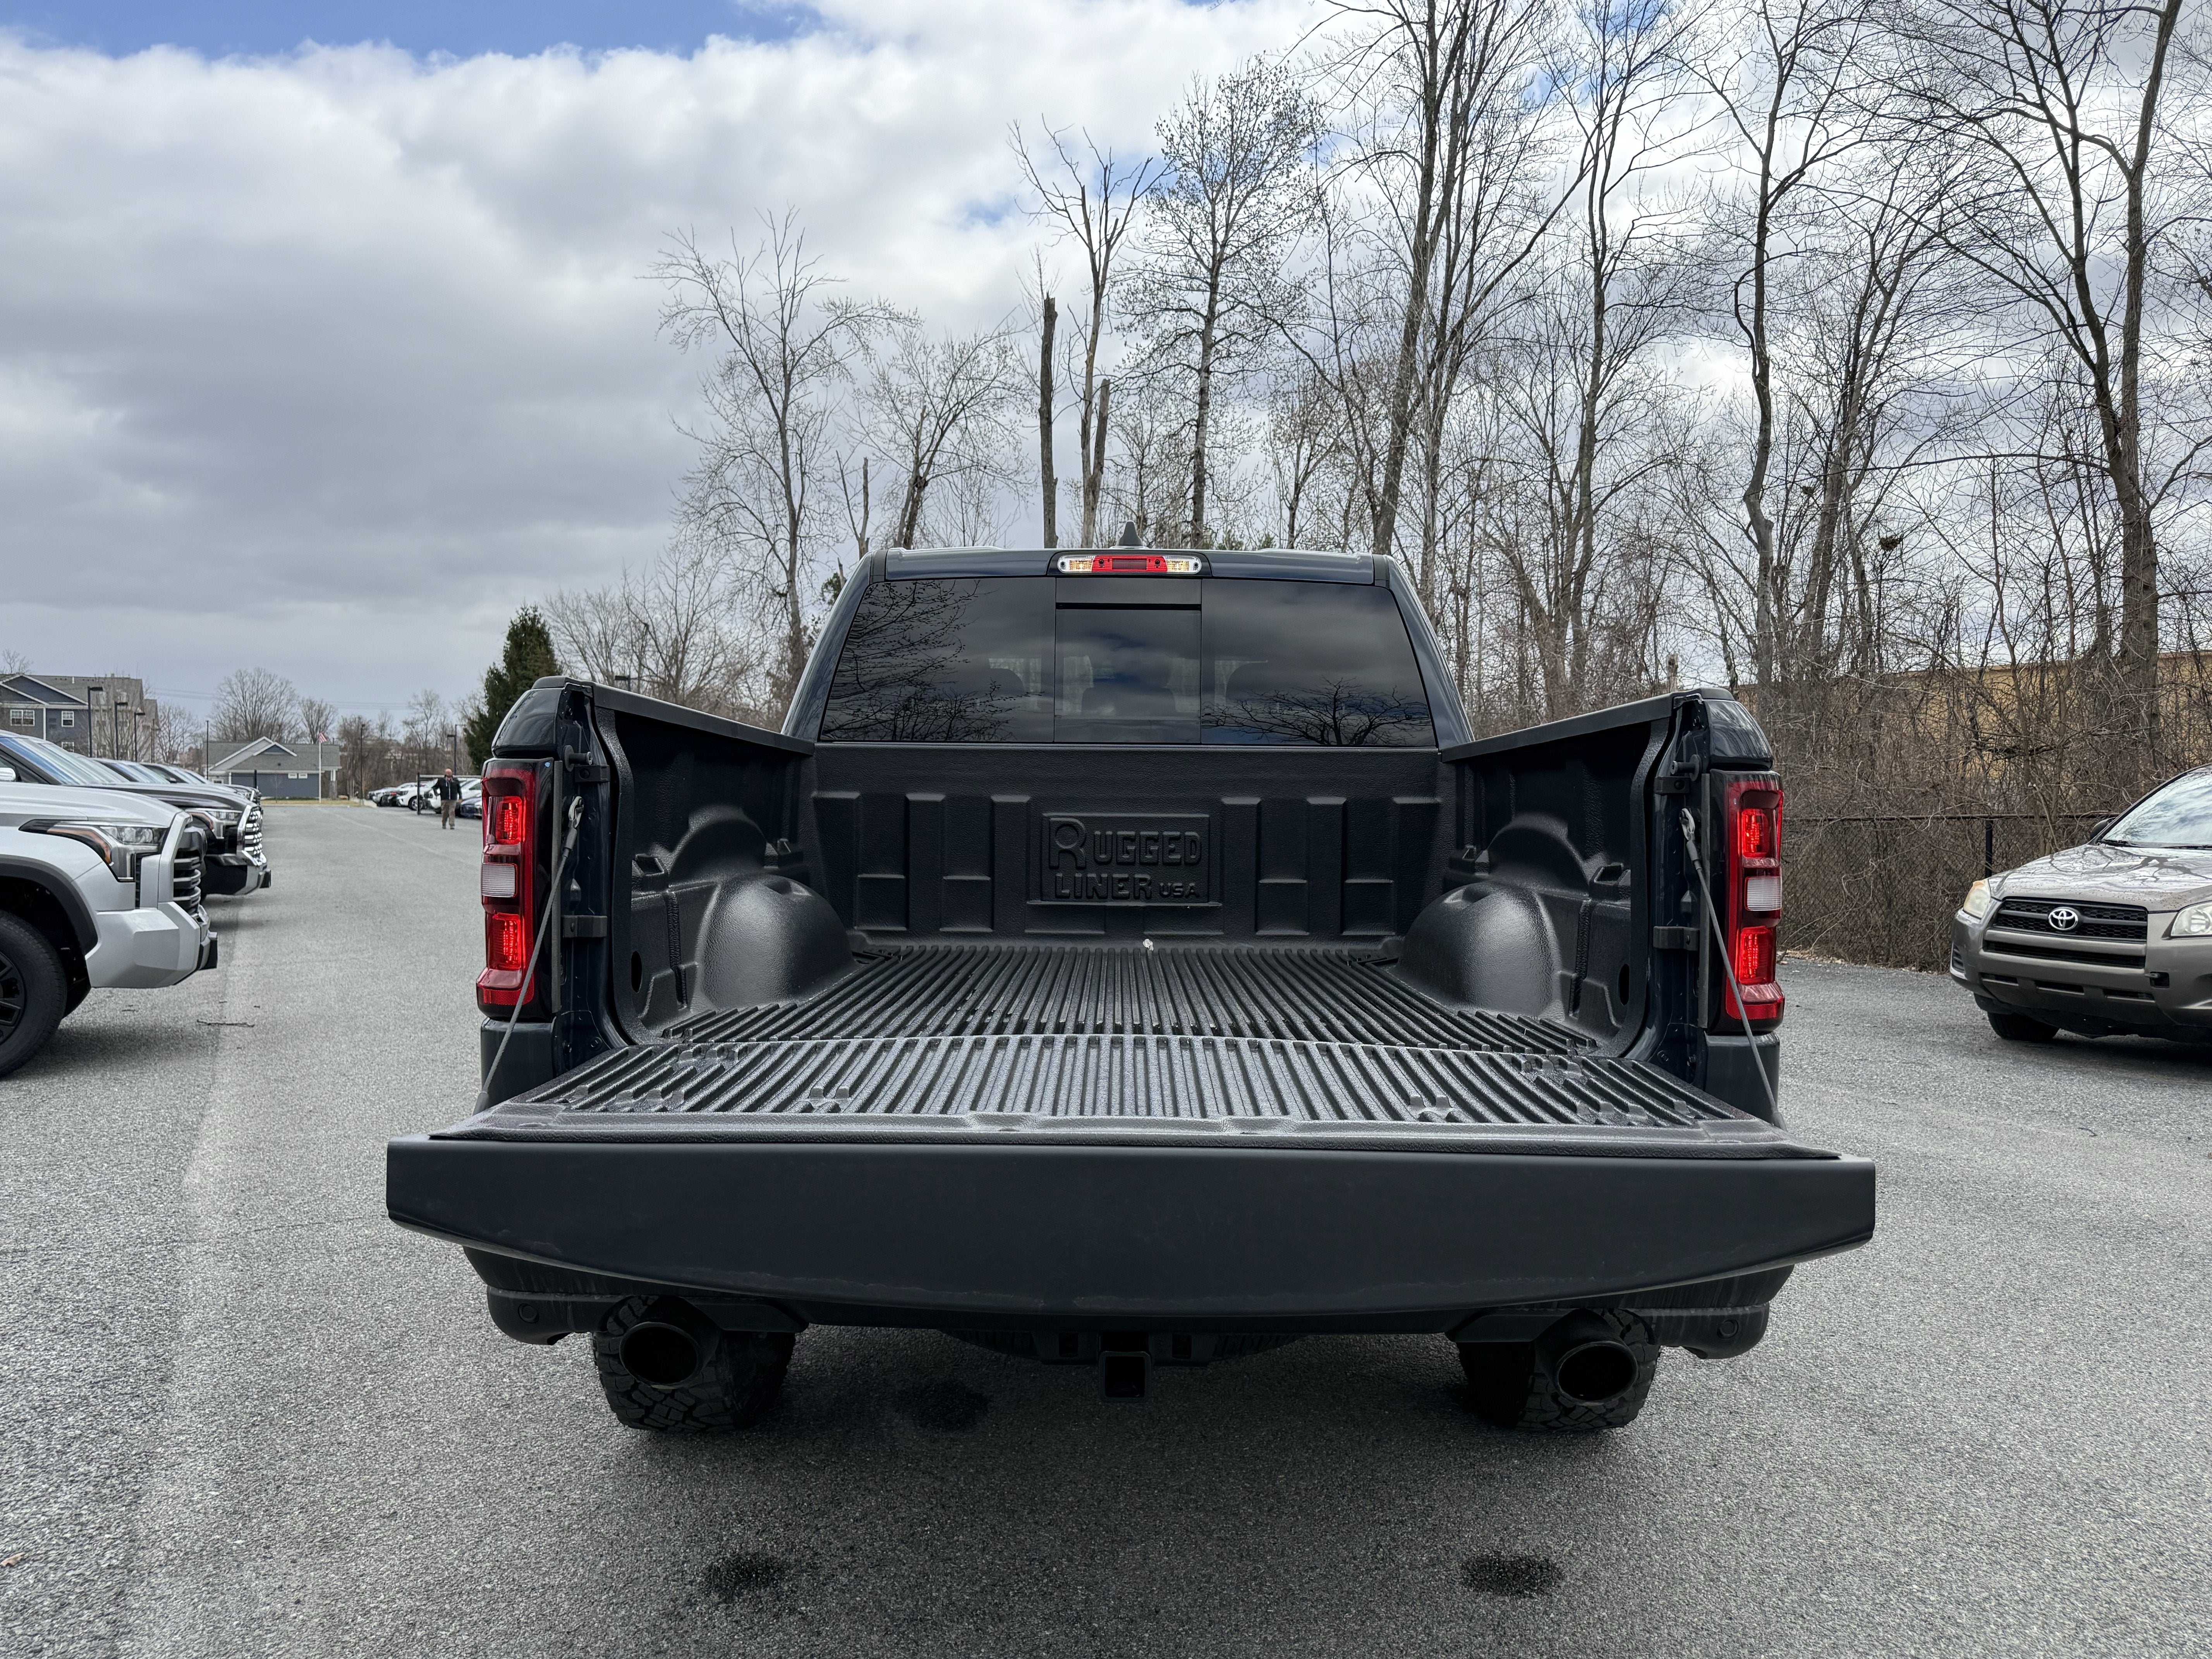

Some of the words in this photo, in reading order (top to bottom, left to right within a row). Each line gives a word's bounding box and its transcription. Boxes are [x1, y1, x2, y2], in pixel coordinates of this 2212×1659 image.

[1049, 817, 1201, 869] RUGGED
[1055, 874, 1152, 899] LINER
[1159, 883, 1200, 898] USA
